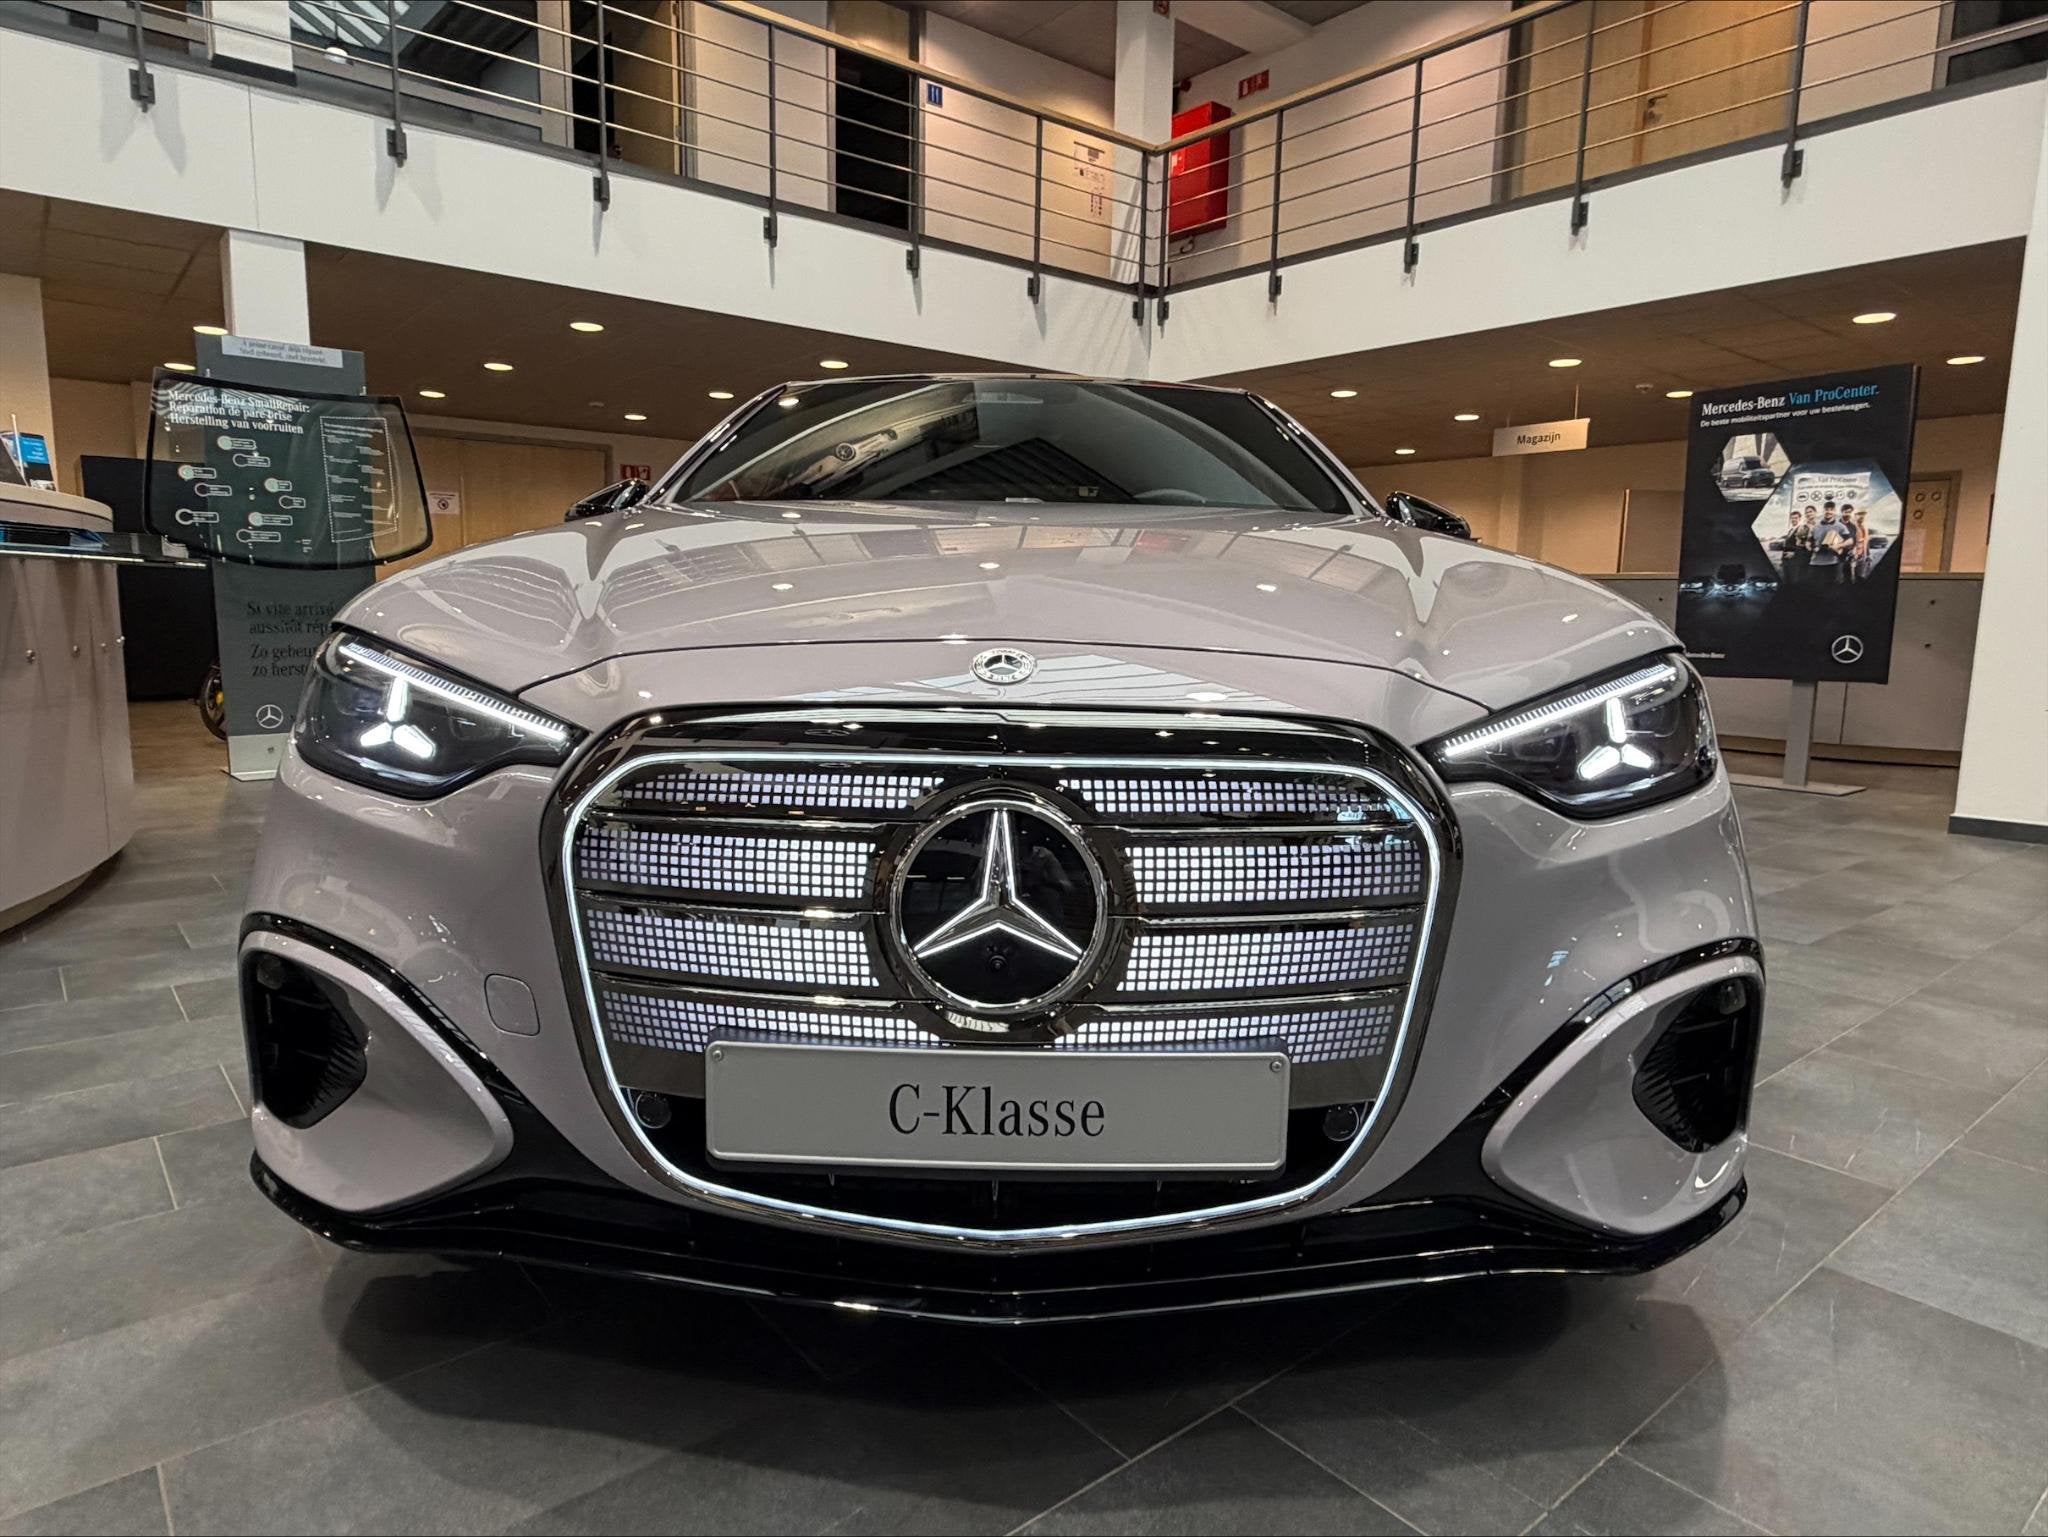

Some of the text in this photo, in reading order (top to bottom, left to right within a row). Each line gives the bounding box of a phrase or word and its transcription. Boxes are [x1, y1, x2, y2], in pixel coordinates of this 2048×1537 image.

[169, 401, 226, 416] Réparation
[228, 407, 241, 417] de
[1702, 384, 1880, 416] Mercedes-Benz Van ProCenter.
[170, 412, 304, 434] Herstelling van voorruiten
[1517, 432, 1561, 446] Magazijn
[306, 619, 330, 637] rép
[889, 1083, 1105, 1137] C-Klasse
